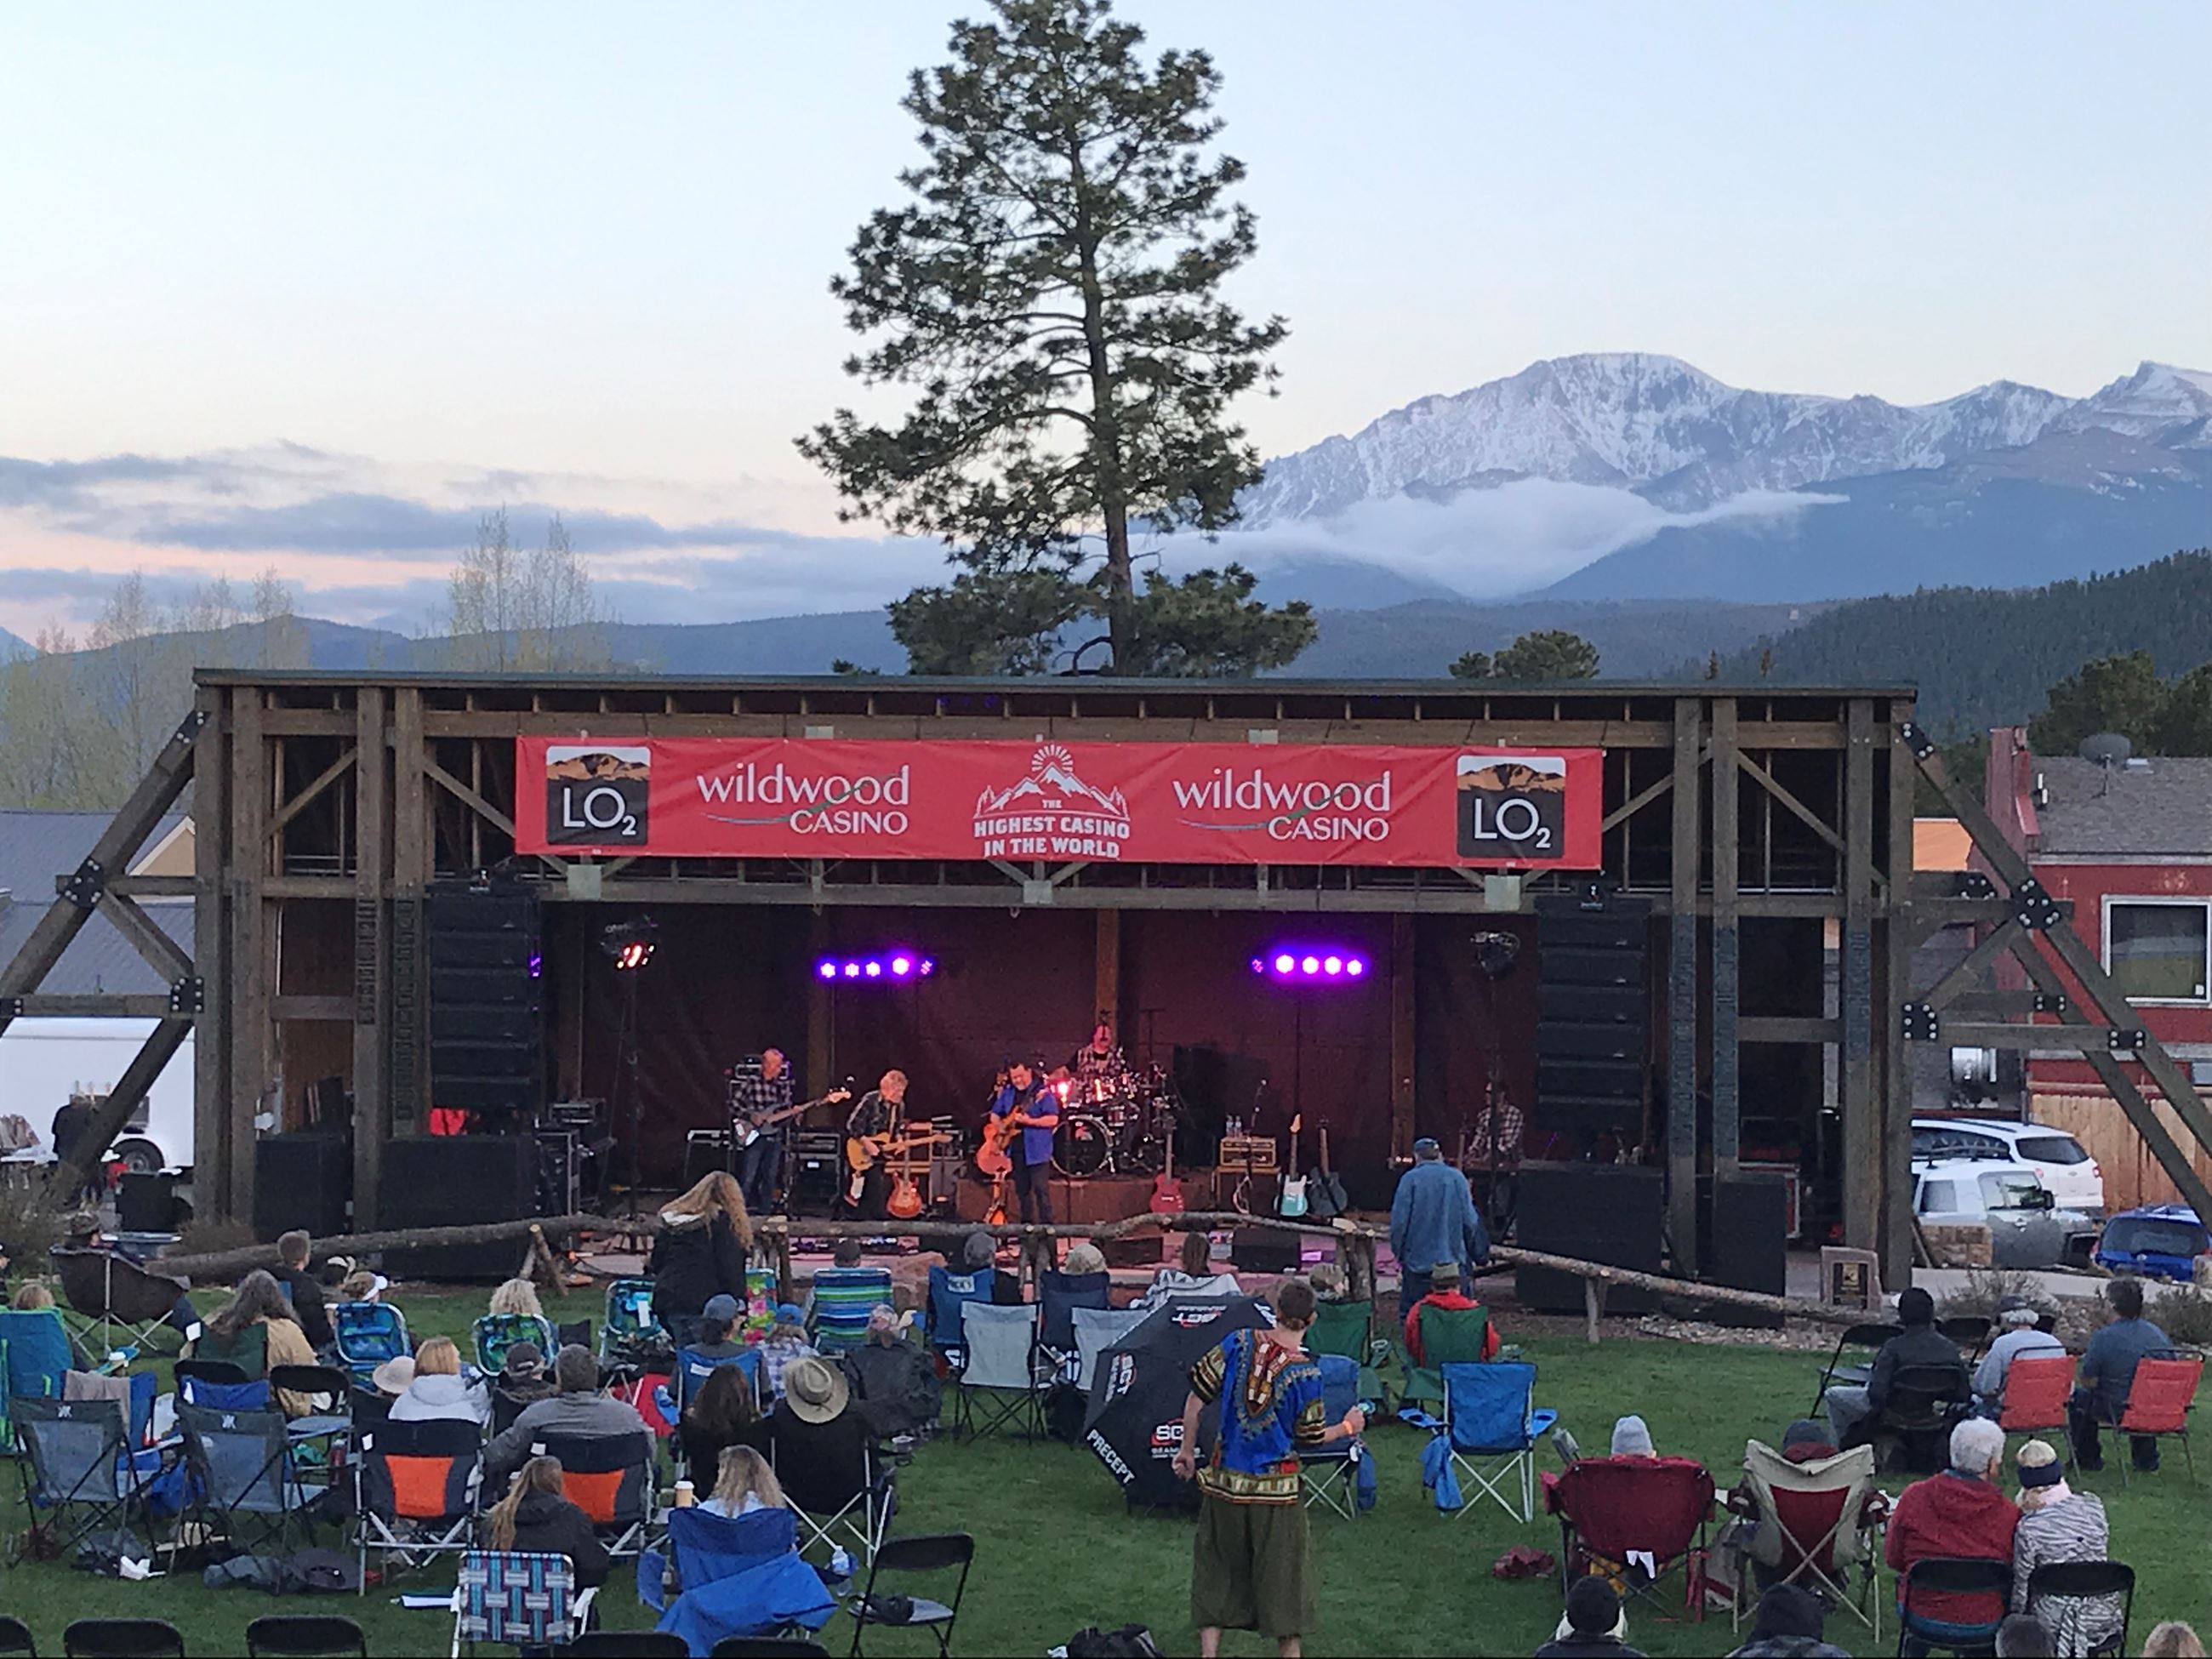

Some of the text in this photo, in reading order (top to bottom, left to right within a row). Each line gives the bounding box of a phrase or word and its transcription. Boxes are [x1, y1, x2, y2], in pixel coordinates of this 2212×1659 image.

[696, 762, 909, 805] wildwood
[1172, 768, 1390, 812] wildwood
[1042, 800, 1063, 808] THE
[790, 810, 909, 835] CASINO
[974, 817, 1130, 840] HIGHEST CASINO
[1268, 817, 1389, 841] CASINO
[983, 836, 1120, 858] IN THE WORLD
[1086, 1428, 1136, 1484] PRECEPT
